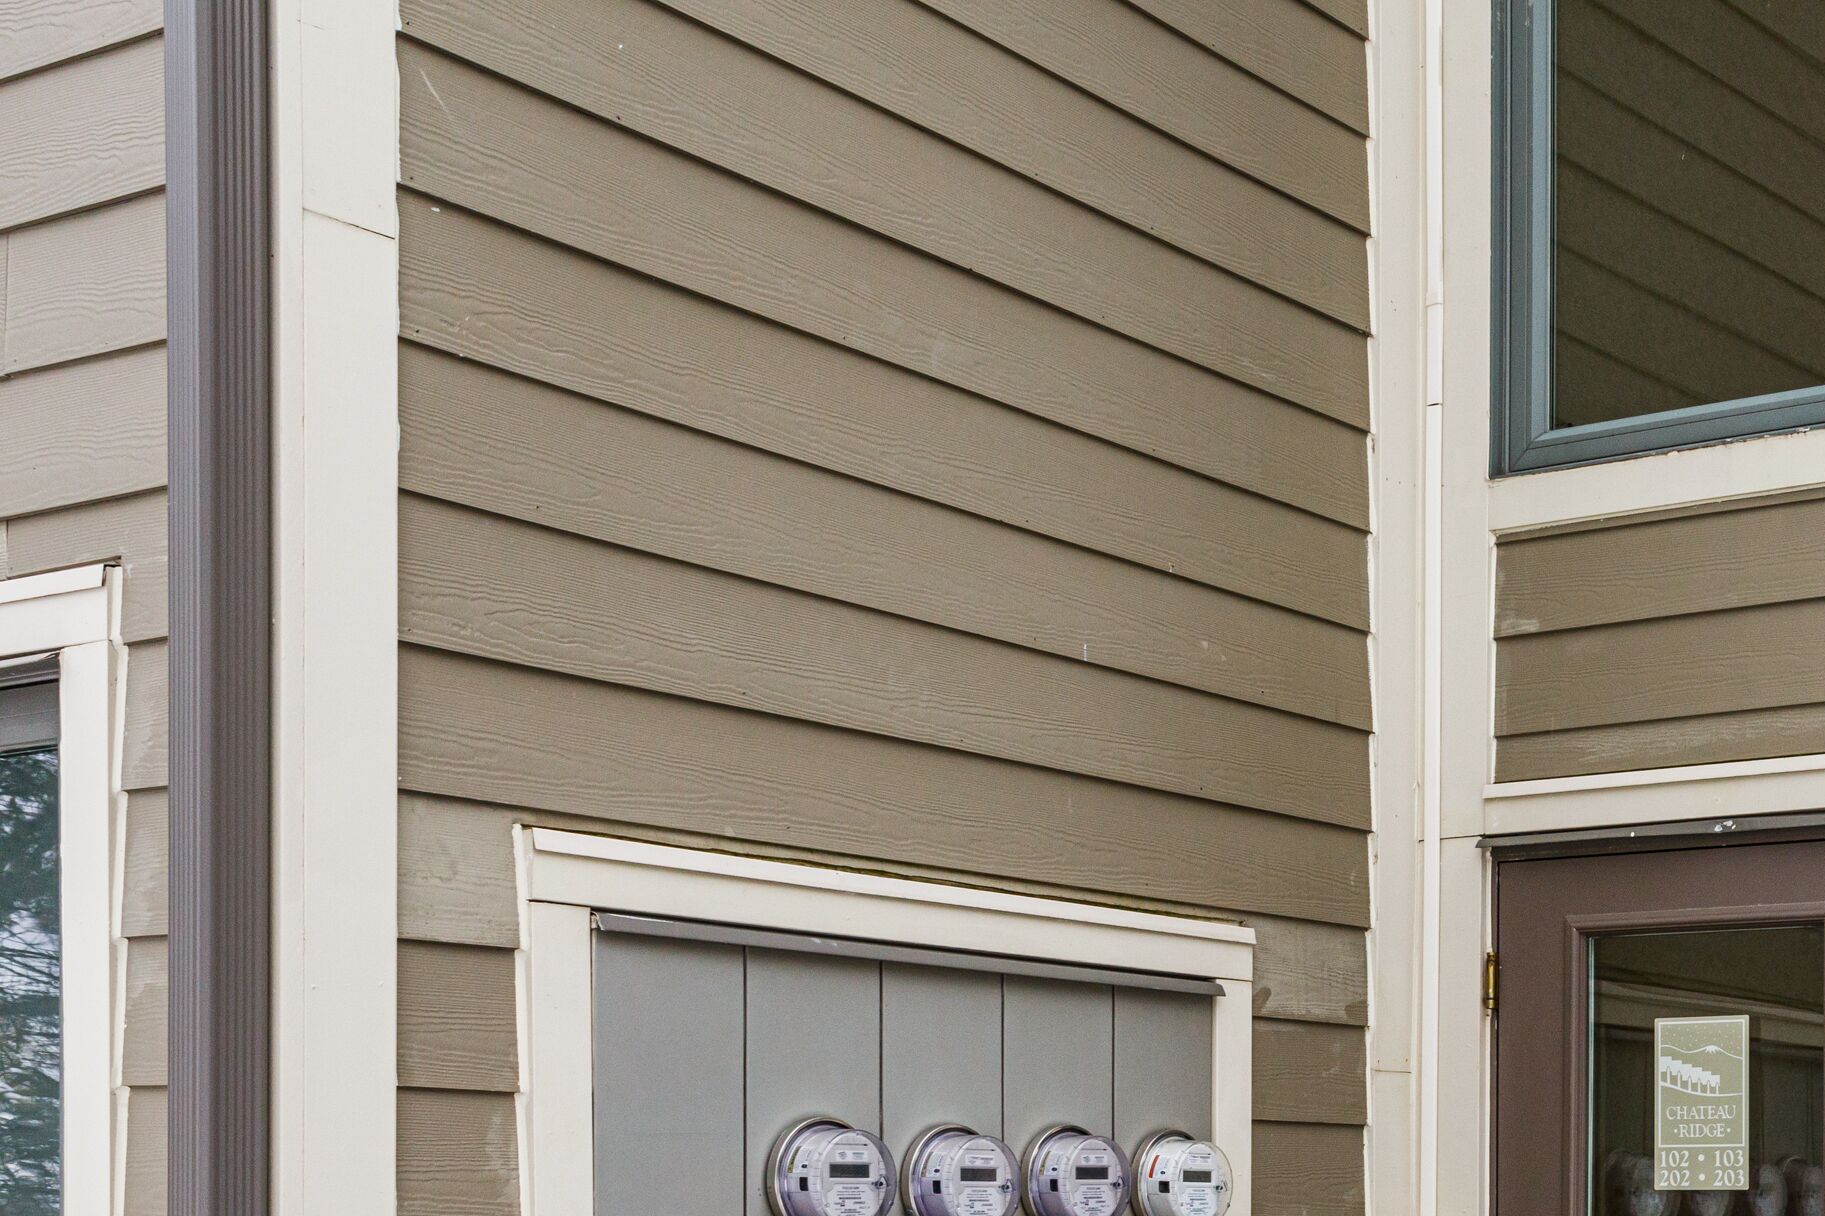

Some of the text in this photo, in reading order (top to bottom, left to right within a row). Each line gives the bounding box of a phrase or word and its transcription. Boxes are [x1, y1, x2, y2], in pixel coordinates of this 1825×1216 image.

[1666, 1105, 1736, 1120] CHATEAU
[1679, 1124, 1725, 1138] RIDGE
[1659, 1150, 1744, 1167] 102 103
[1659, 1169, 1745, 1186] 202 203
